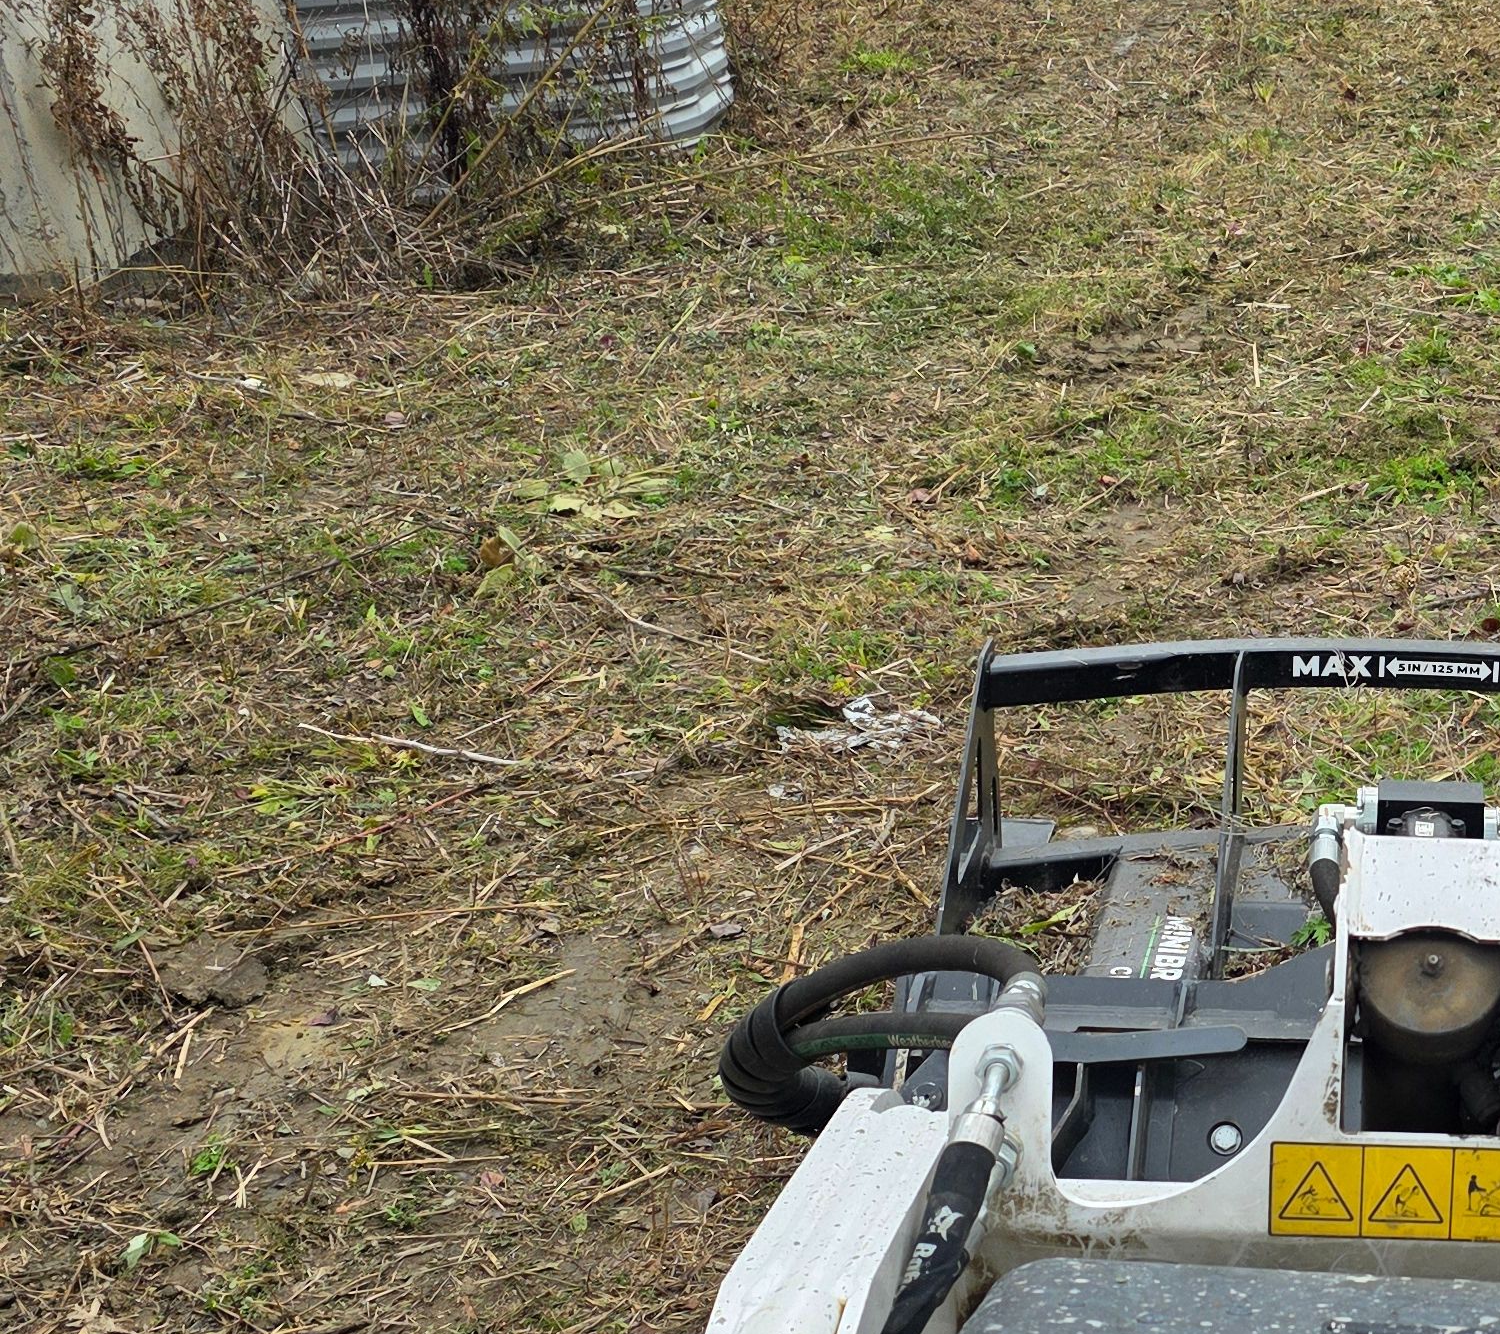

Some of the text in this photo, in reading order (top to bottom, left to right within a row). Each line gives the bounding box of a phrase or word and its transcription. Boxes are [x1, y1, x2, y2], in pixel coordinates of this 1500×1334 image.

[1292, 655, 1371, 678] MAX
[1432, 665, 1454, 674] 125
[1457, 666, 1480, 675] MM
